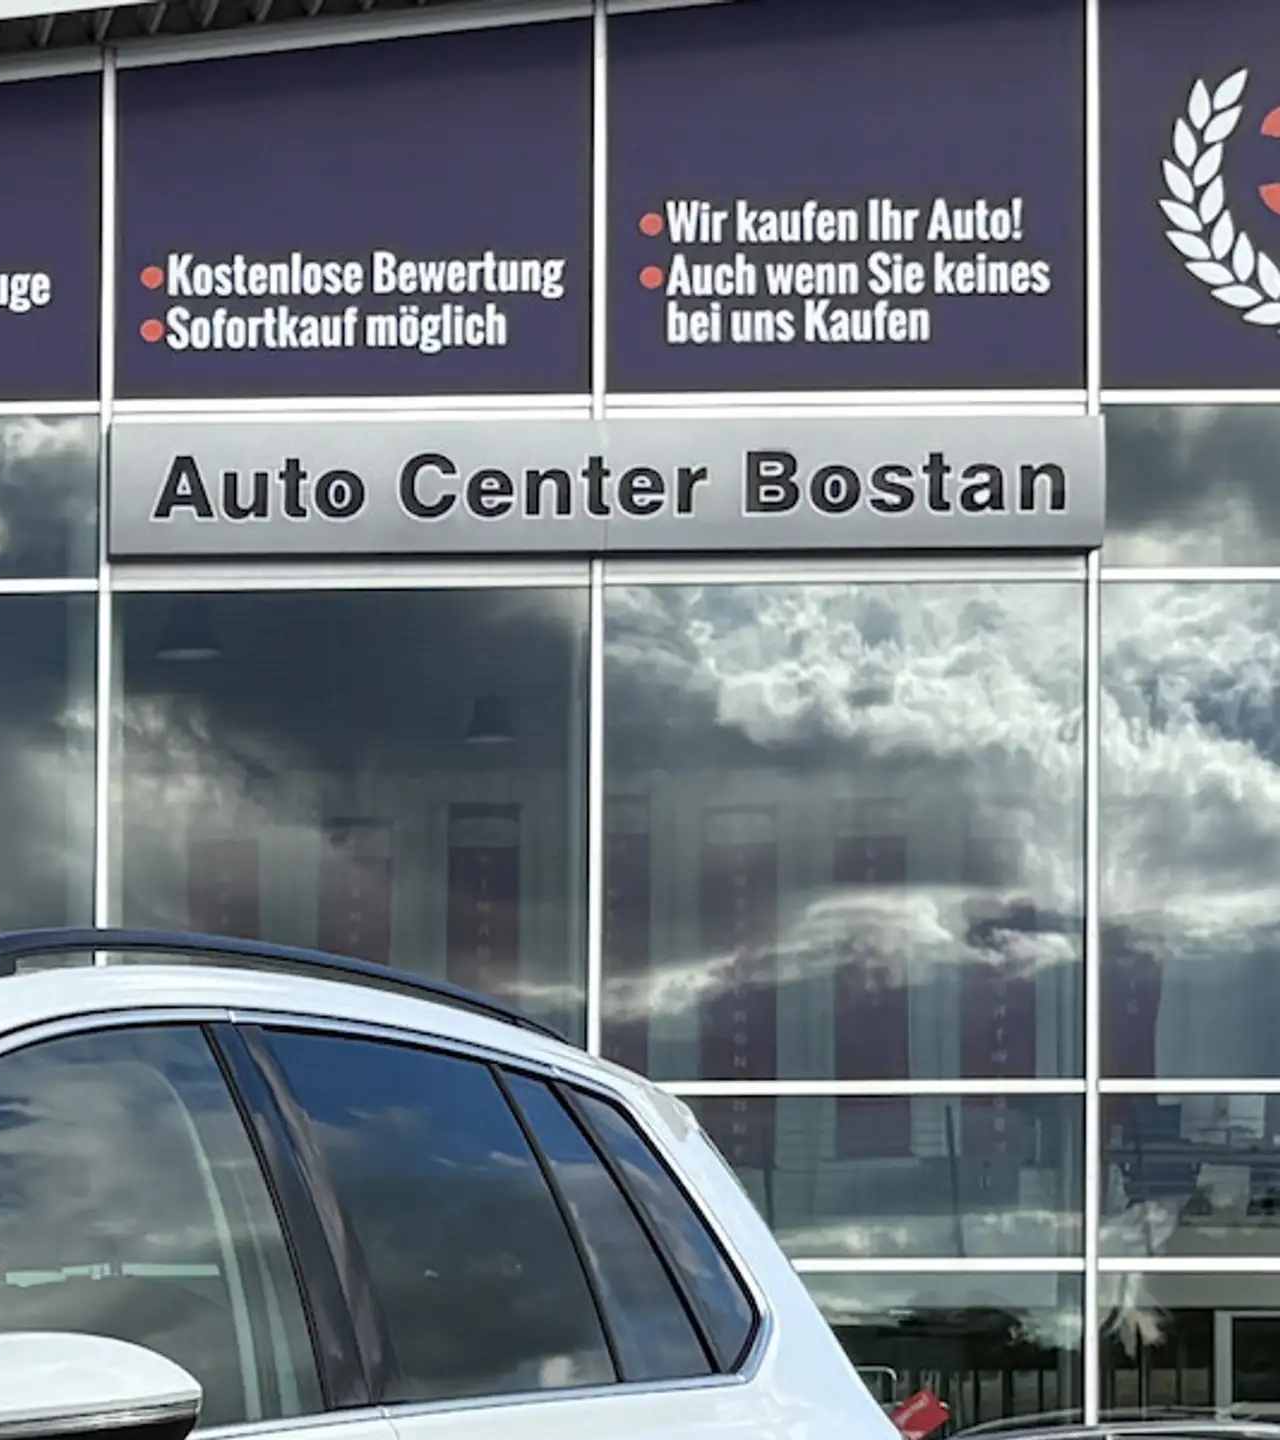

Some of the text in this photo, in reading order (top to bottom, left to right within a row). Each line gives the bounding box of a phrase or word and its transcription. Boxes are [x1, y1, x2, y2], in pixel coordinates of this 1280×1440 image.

[666, 197, 1023, 243] Wir kaufen Ihr Auto!
[167, 250, 566, 300] Kostenlose Bewertung
[666, 250, 1051, 297] Auch wenn Sie keines
[166, 302, 507, 354] Sofortkauf möglich
[667, 298, 930, 344] bei uns Kaufen
[153, 450, 1067, 520] Auto Center Bostan
